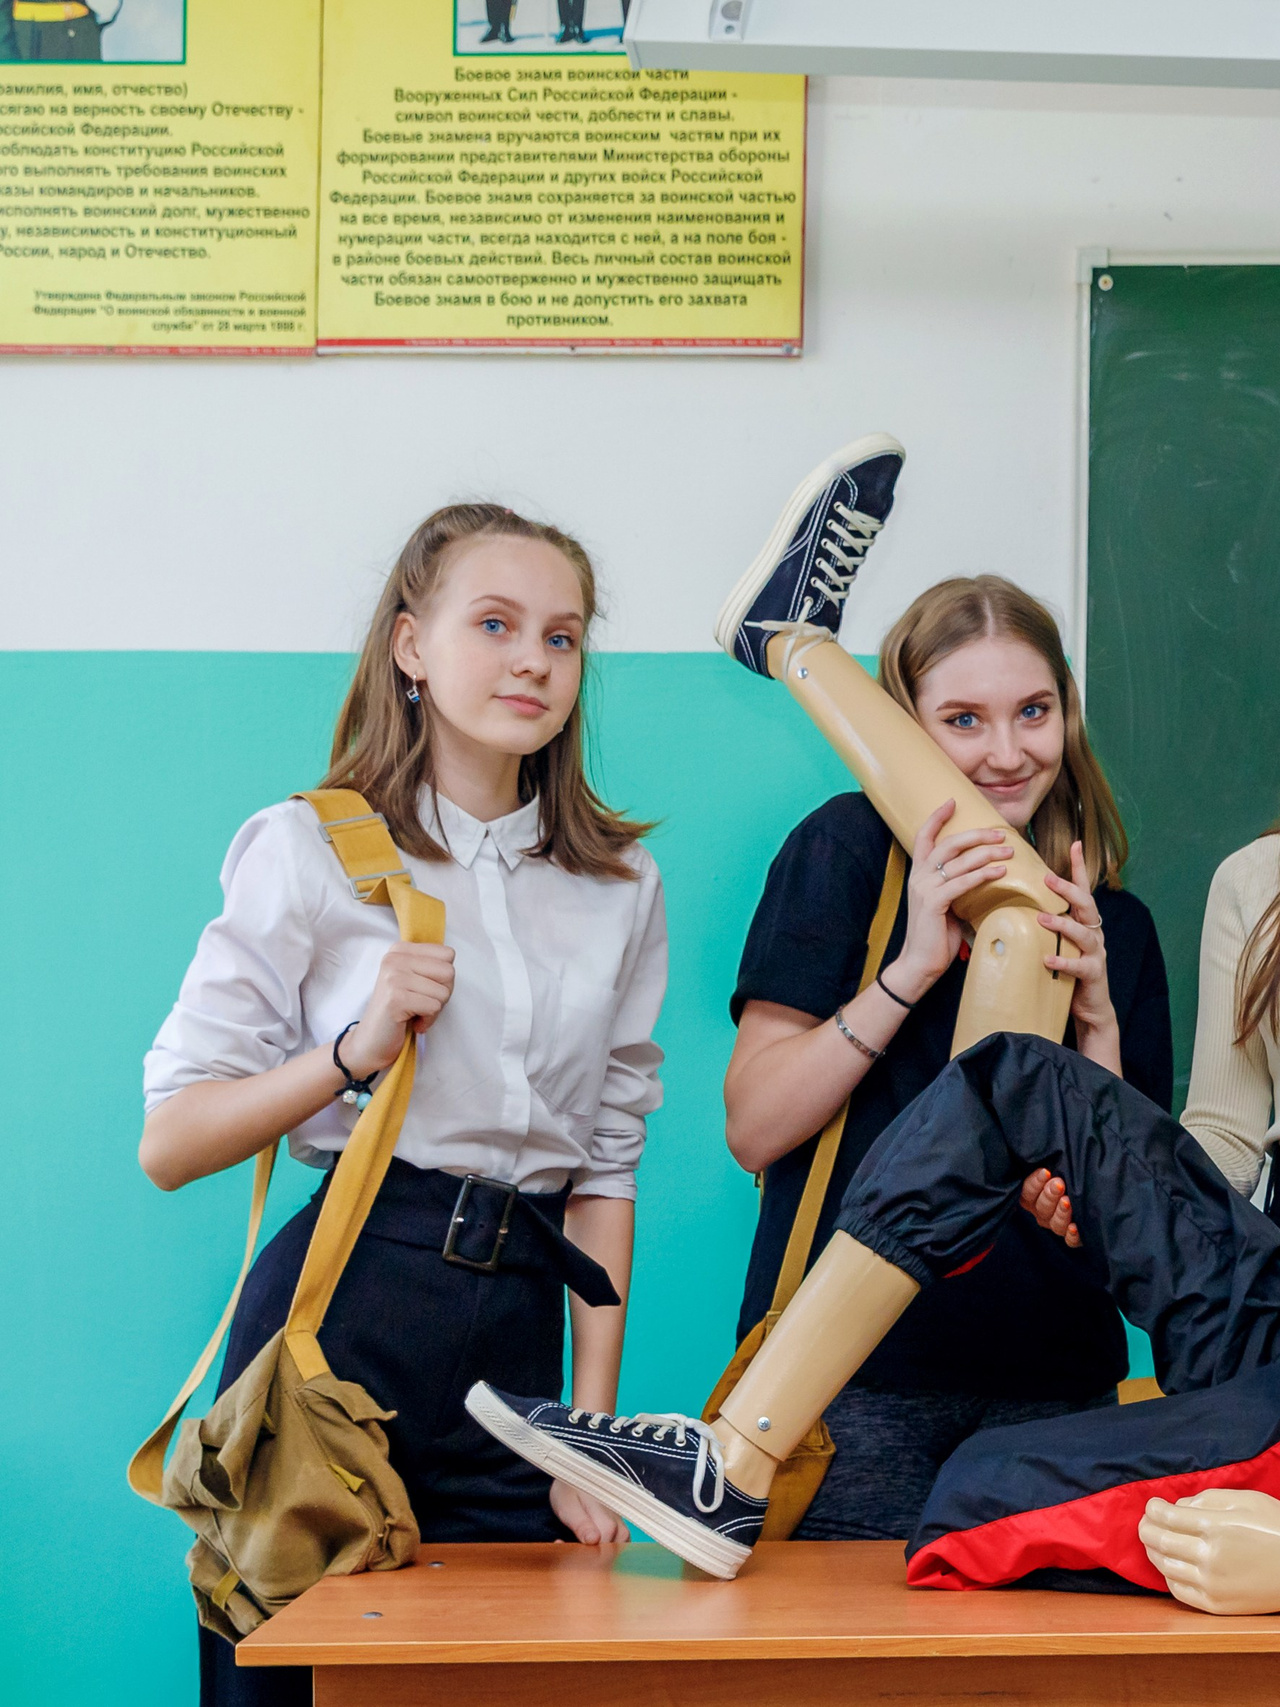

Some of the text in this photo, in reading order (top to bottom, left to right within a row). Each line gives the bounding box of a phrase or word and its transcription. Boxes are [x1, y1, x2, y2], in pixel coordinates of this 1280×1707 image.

[454, 66, 512, 82] Боевое
[515, 69, 563, 82] знамя
[645, 68, 689, 80] части
[72, 84, 107, 97] имя,
[111, 82, 188, 99] отчество)
[393, 87, 503, 106] Вооруженных
[506, 86, 538, 102] Сил
[542, 86, 635, 102] Российской
[638, 86, 727, 105] Федерации
[49, 104, 68, 116] на
[72, 104, 146, 119] верность
[149, 104, 208, 120] своему
[211, 101, 294, 120] Отечеству
[394, 106, 735, 124] символ воинской чести, доблести и славы.
[79, 122, 173, 139] Федерации.
[362, 128, 781, 147] Боевые знамена вручаются воинским частям при их
[0, 141, 285, 162] облюдать конституцию Российской
[336, 146, 790, 167] формировании представителями Министерства обороны
[22, 165, 112, 177] выполнять
[116, 161, 209, 180] требования
[212, 165, 287, 178] воинских
[361, 168, 763, 187] Российской Федерации и других войск Российской
[38, 185, 135, 200] командиров
[138, 186, 149, 197] и
[152, 185, 260, 198] начальников.
[328, 188, 797, 208] Федерации. Боевое знамя сохраняется за воинской частью
[82, 203, 158, 218] воинский
[160, 206, 201, 220] долг,
[205, 206, 311, 222] мужественно
[339, 212, 785, 228] на все время, независимо от изменения наименования и
[15, 225, 136, 238] независимость
[140, 227, 150, 238] и
[154, 223, 298, 242] конституционный
[337, 233, 423, 249] нумерации
[427, 233, 475, 246] части,
[479, 233, 531, 246] всегда
[534, 232, 616, 247] находится
[620, 233, 629, 245] с
[633, 229, 666, 246] ней,
[669, 233, 679, 245] а
[683, 232, 702, 245] на
[706, 232, 744, 245] поле
[747, 229, 777, 245] боя
[58, 246, 107, 261] народ
[110, 247, 120, 258] и
[123, 243, 211, 259] Отечество.
[332, 250, 792, 269] в районе боевых действий. Весь личный состав воинской
[340, 270, 782, 289] части обязан самоотверженно и мужественно защищать
[373, 290, 748, 310] Боевое знамя в бою и не допустить его захвата
[506, 314, 614, 329] противником.
